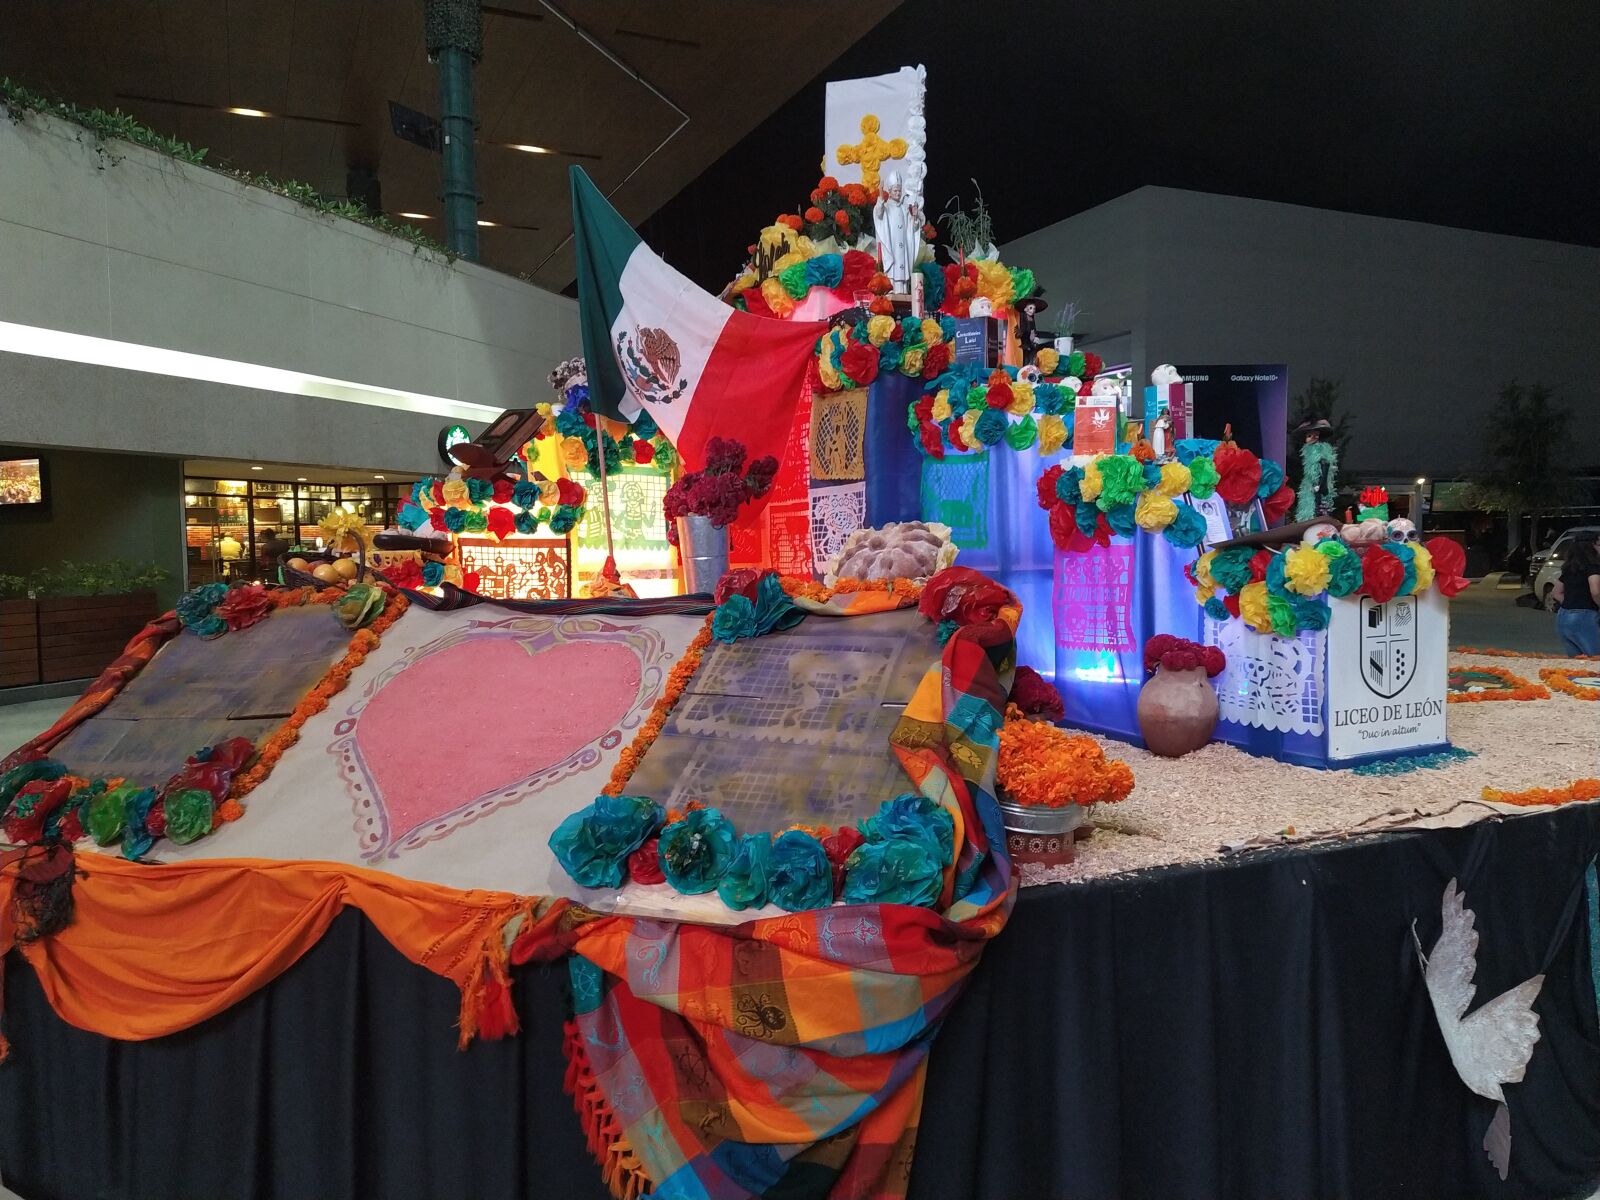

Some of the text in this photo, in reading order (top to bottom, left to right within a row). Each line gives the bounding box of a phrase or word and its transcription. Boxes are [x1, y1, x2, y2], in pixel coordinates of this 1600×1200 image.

[1335, 697, 1443, 727] LICEO DE LEÓN
[1381, 728, 1391, 738] in
